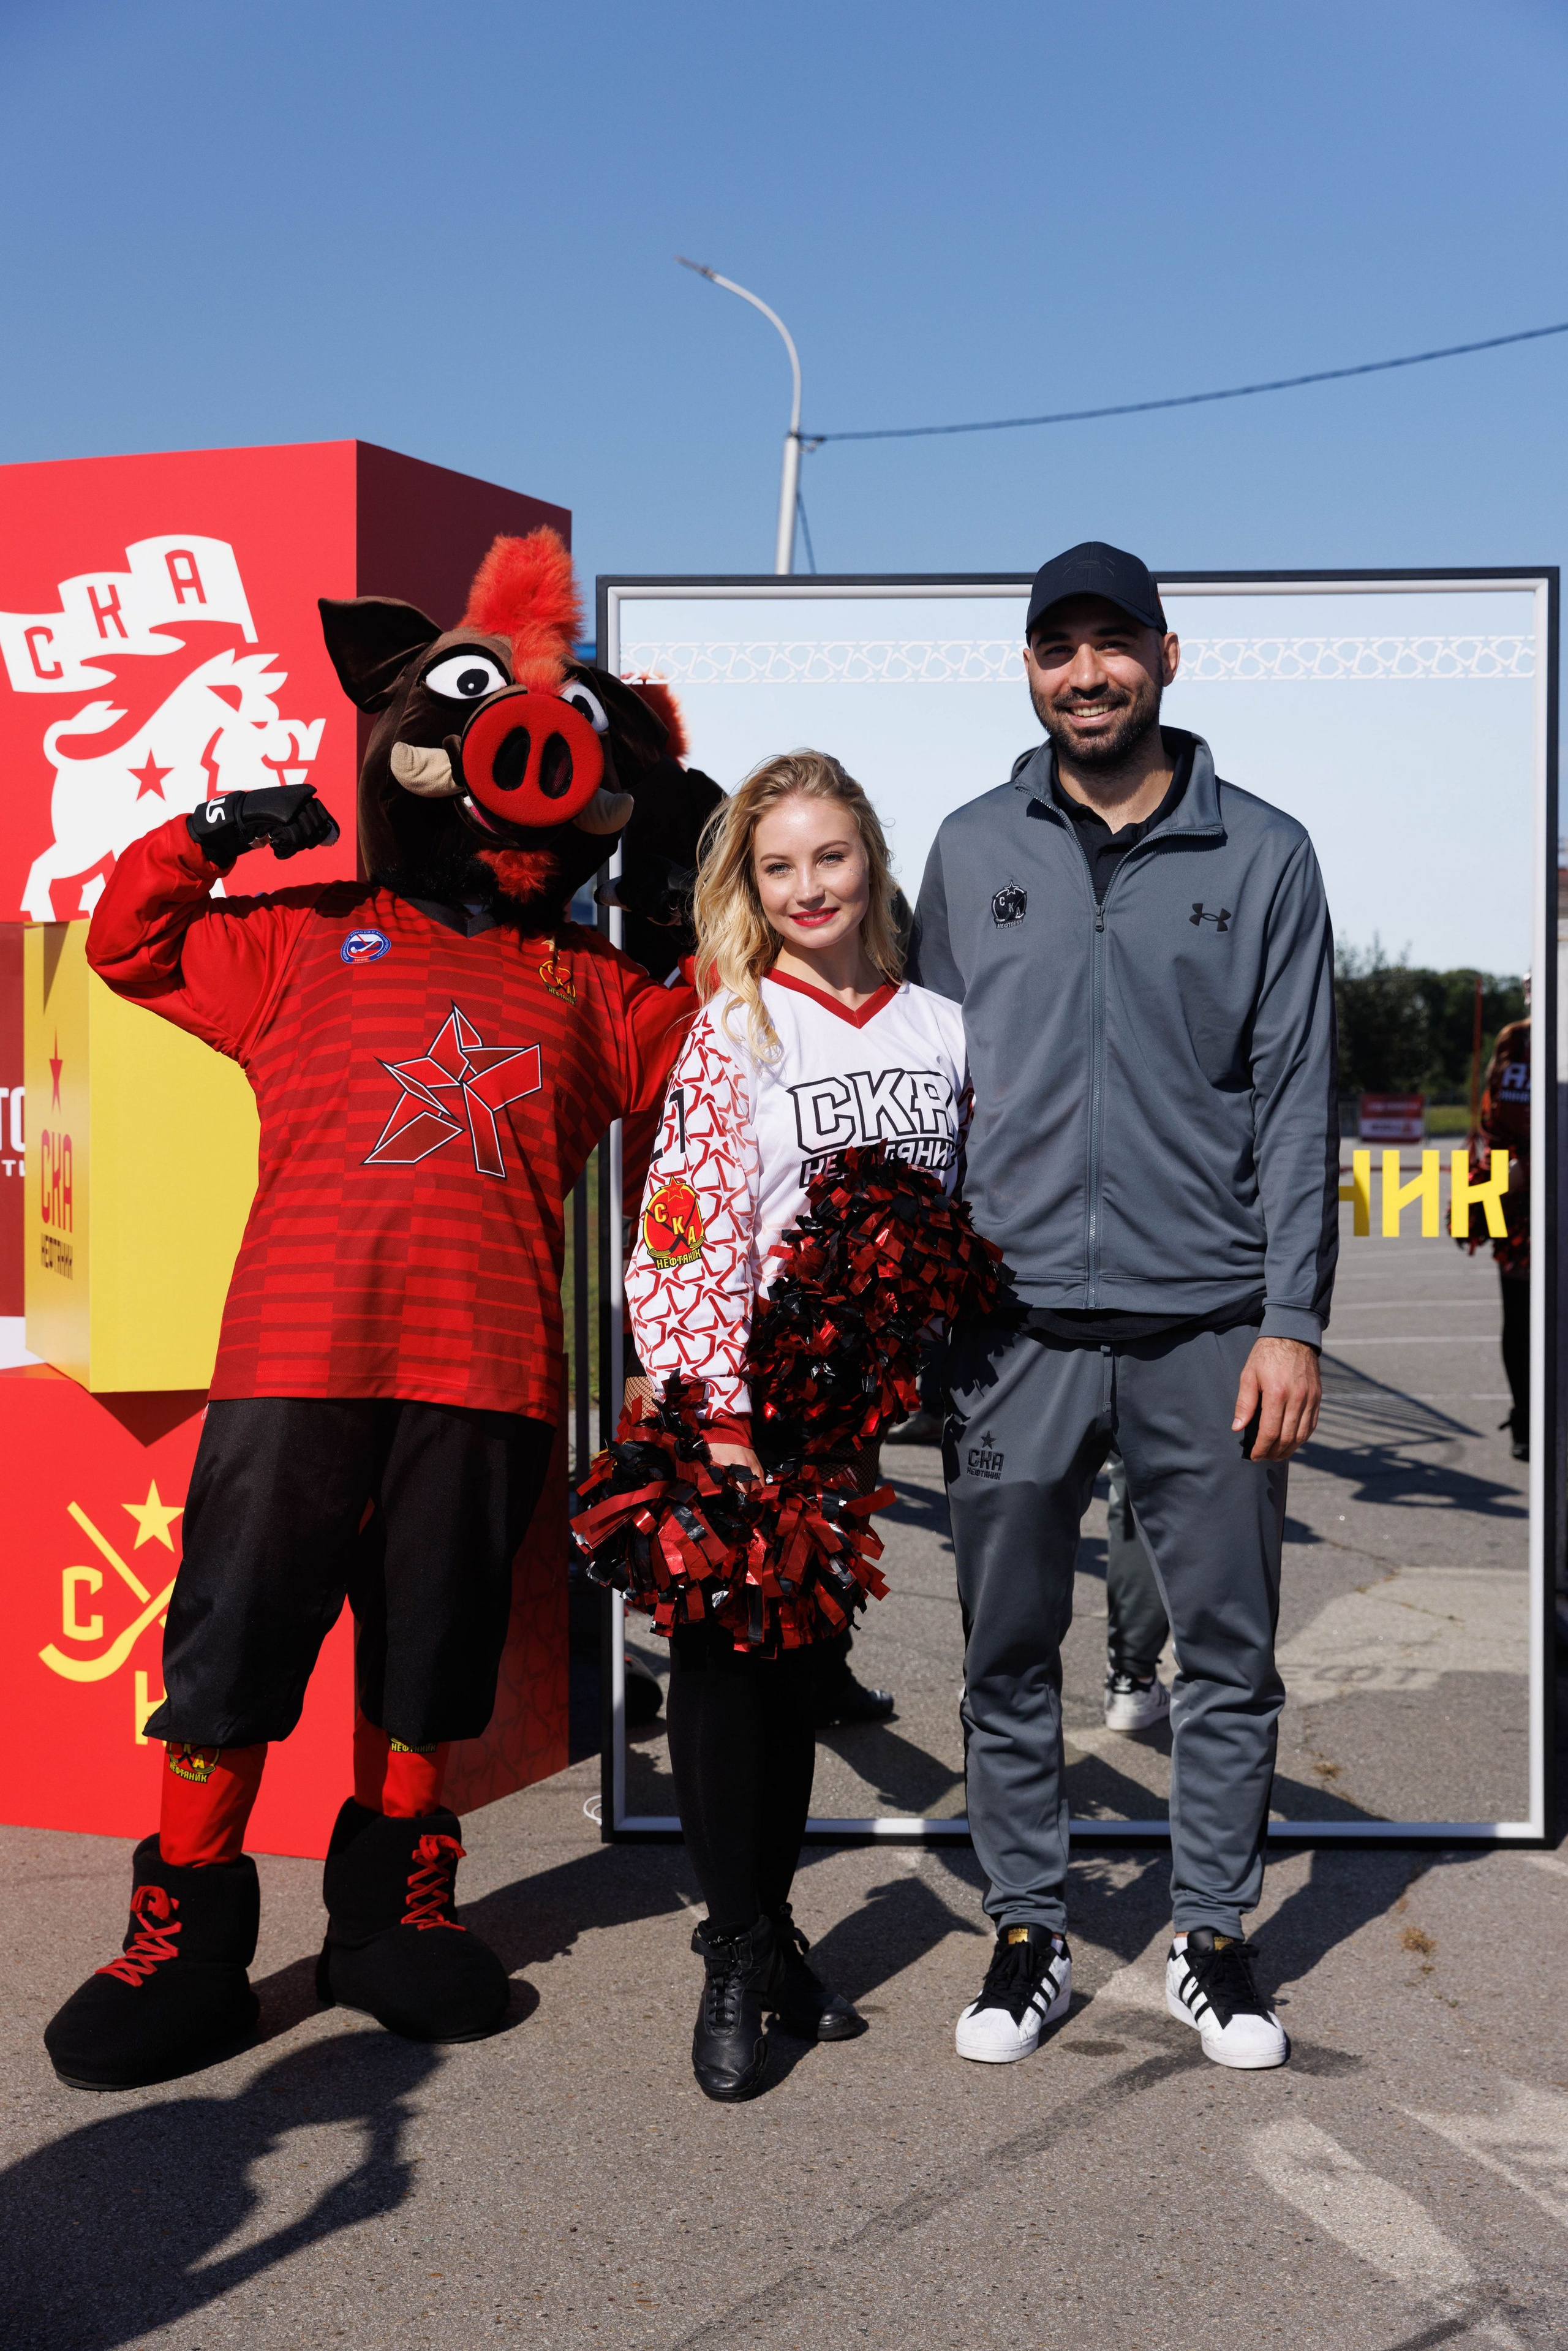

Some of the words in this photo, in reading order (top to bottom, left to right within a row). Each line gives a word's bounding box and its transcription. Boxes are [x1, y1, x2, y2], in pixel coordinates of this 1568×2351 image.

[24, 549, 208, 680] СКА
[42, 1129, 72, 1233] СКА
[656, 1248, 701, 1269] НЕФТЯНИК
[968, 1449, 1005, 1472] СКА
[967, 1467, 1001, 1480] НЕФТЯНИК
[170, 1761, 207, 1783] НЕФТЯНИК
